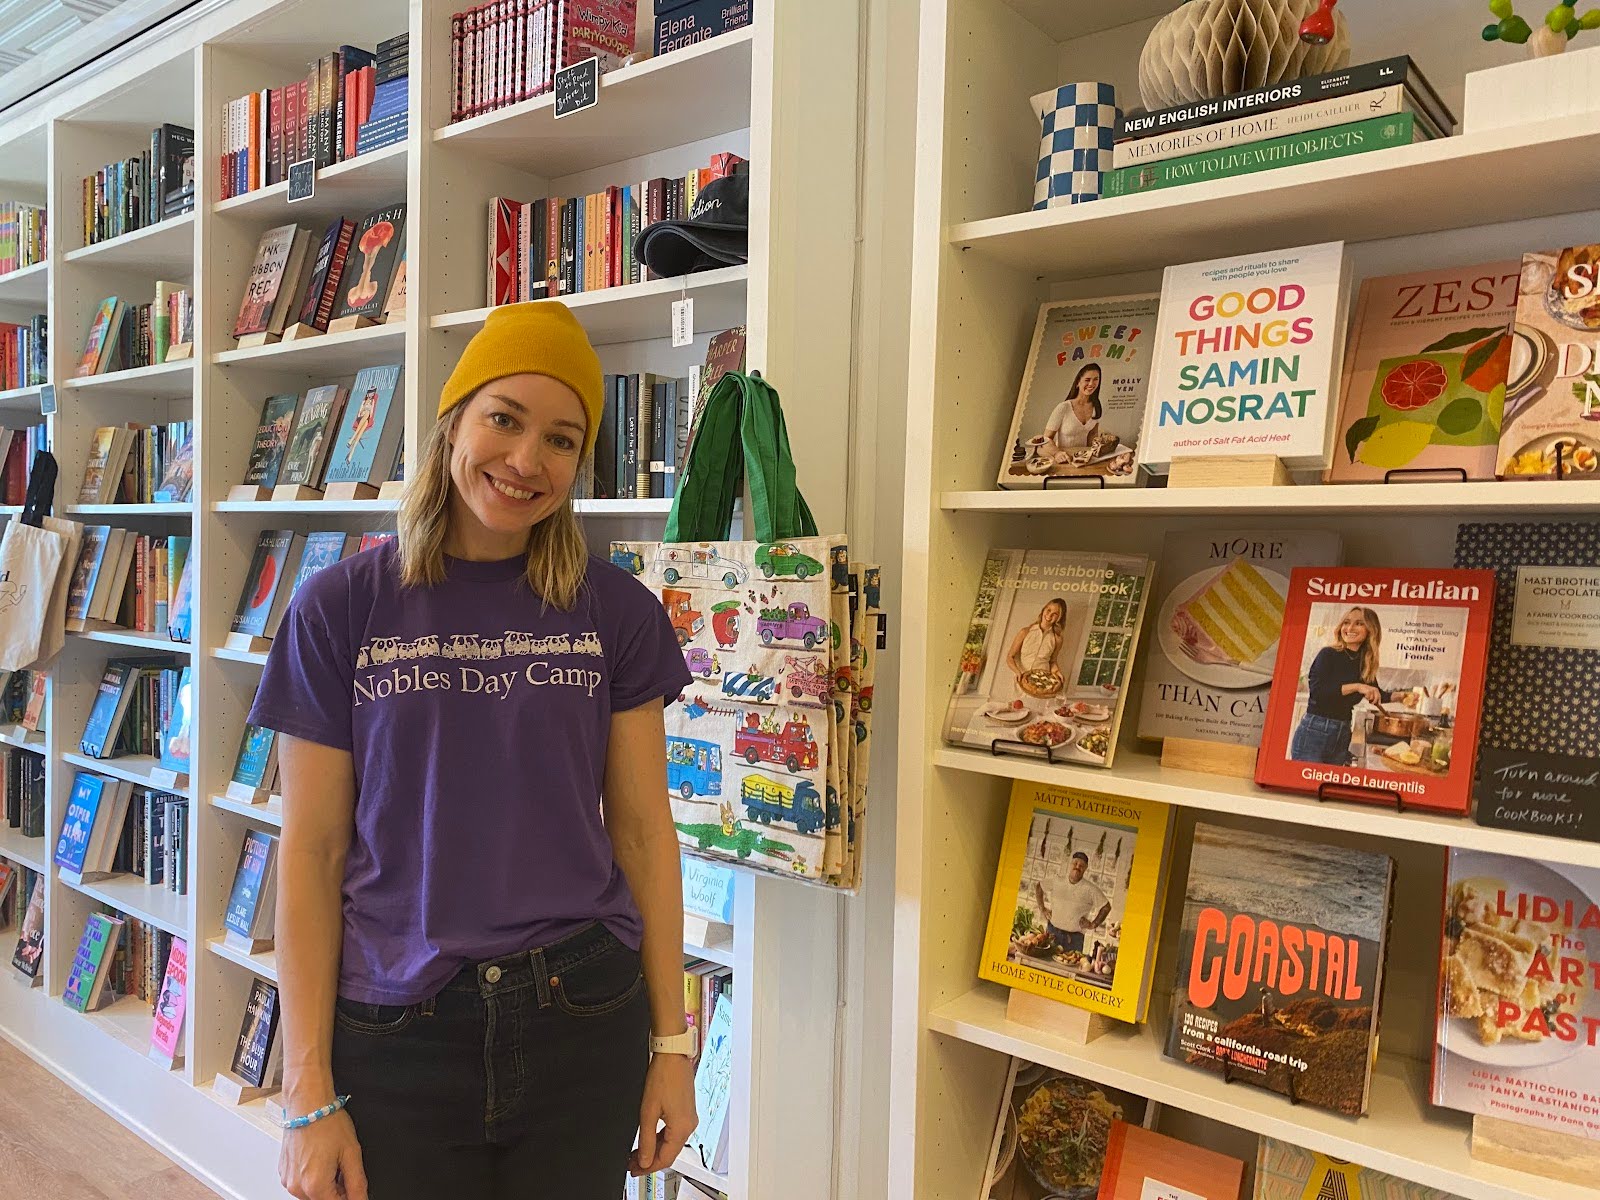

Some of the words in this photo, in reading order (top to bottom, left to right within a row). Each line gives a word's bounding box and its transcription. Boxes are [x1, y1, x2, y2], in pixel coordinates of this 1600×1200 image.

[577, 4, 611, 32] Wimpy
[611, 16, 629, 38] Kid
[721, 1, 749, 19] Brilliant
[724, 10, 748, 29] Friend
[660, 15, 695, 39] Elena
[659, 26, 713, 56] Ferrante
[556, 69, 575, 90] Stuff
[565, 81, 572, 90] to
[572, 68, 589, 87] Read
[1320, 75, 1350, 85] ELIZABETH
[557, 88, 580, 111] Before
[1124, 117, 1156, 133] NEW
[1158, 102, 1219, 126] ENGLISH
[1222, 85, 1302, 113] INTERIORS
[1287, 112, 1312, 125] HEIDI
[1314, 102, 1361, 119] CAILLIER
[1127, 132, 1203, 160] MEMORIES
[1205, 129, 1228, 144] OF
[1230, 117, 1279, 139] HOME
[1165, 163, 1199, 180] HOW
[1200, 158, 1219, 175] TO
[1219, 151, 1252, 170] LIVE
[1254, 142, 1295, 164] WITH
[1295, 131, 1364, 156] OBJECTS
[362, 208, 403, 230] FLESH
[263, 243, 281, 257] INK
[334, 253, 345, 266] IS
[251, 259, 284, 277] RIBBON
[327, 267, 341, 287] SHE
[1202, 267, 1228, 277] recipes
[1230, 264, 1244, 273] and
[1245, 260, 1268, 272] rituals
[1268, 259, 1277, 267] to
[1278, 257, 1300, 267] share
[1211, 273, 1227, 282] with
[1228, 271, 1254, 281] people
[1255, 269, 1269, 278] you
[1270, 265, 1288, 274] love
[249, 280, 272, 296] RED
[1392, 273, 1521, 320] ZEST
[316, 288, 335, 325] HIDING
[1189, 284, 1306, 322] GOOD
[1062, 324, 1142, 346] SWEET
[1175, 317, 1314, 356] THINGS
[708, 338, 738, 361] HARPER
[1056, 344, 1137, 366] FARM!
[709, 363, 724, 380] LEE
[1112, 377, 1142, 385] MOLLY
[1178, 355, 1300, 391] SAMIN
[1158, 389, 1316, 427] NOSRAT
[256, 440, 279, 449] THEORY
[1173, 438, 1200, 448] author
[1202, 437, 1213, 446] of
[1212, 436, 1230, 446] Salt
[1231, 436, 1245, 445] Fat
[1246, 434, 1267, 443] Acid
[1269, 433, 1291, 442] Heat
[1209, 537, 1282, 560] MORE
[1015, 563, 1039, 575] the
[1043, 564, 1115, 579] wishbone
[1524, 577, 1554, 585] MAST
[1555, 577, 1600, 587] BROTHE
[996, 577, 1048, 591] kitchen
[1052, 581, 1128, 596] cookbook
[1306, 577, 1387, 601] Super
[1391, 579, 1480, 601] Italian
[1532, 587, 1600, 597] CHOCOLATE
[233, 614, 251, 624] SUSAN
[1396, 643, 1446, 653] Healthiest
[1405, 652, 1434, 661] Foods
[353, 665, 450, 707] Nobles
[459, 666, 518, 700] Day
[525, 661, 601, 697] Camp
[1158, 683, 1221, 713] THAN
[1230, 694, 1265, 718] CA
[1165, 713, 1183, 722] Baking
[1184, 715, 1205, 724] Recipes
[1301, 768, 1340, 784] Giada
[1342, 773, 1361, 786] De
[1362, 775, 1426, 795] Laurentiis
[1494, 762, 1539, 783] Turn
[1544, 771, 1599, 787] around
[78, 786, 92, 801] MY
[1496, 783, 1523, 800] for
[1531, 791, 1569, 803] more
[68, 803, 91, 823] OTHER
[1033, 791, 1075, 807] MATTY
[1075, 800, 1143, 820] MATHESON
[62, 823, 86, 844] HEART
[689, 866, 724, 888] Virginia
[692, 886, 717, 908] Woolf
[1496, 889, 1600, 931] LIDIA
[1550, 933, 1586, 952] The
[1188, 907, 1363, 1009] COASTAL
[1525, 956, 1600, 991] ART
[991, 961, 1026, 981] HOME
[1028, 972, 1064, 992] STYLE
[1066, 983, 1124, 1009] COOKERY
[254, 990, 270, 1007] PAULA
[1555, 991, 1577, 1007] of
[247, 1002, 271, 1025] HAWKINS
[1194, 1015, 1219, 1034] RECIPES
[1495, 1000, 1600, 1047] PAST
[239, 1034, 251, 1050] THE
[251, 1042, 265, 1059] BLUE
[1180, 1039, 1196, 1049] Scott
[1182, 1025, 1205, 1042] from
[1207, 1033, 1213, 1042] a
[1214, 1036, 1262, 1057] california
[1263, 1051, 1288, 1065] road
[1288, 1055, 1308, 1072] trip
[240, 1054, 258, 1072] HOUR
[1231, 1050, 1268, 1071] LUNCHEONETTE
[1472, 1069, 1500, 1081] LIDIA
[1505, 1076, 1578, 1099] MATTICCHIO
[1468, 1081, 1486, 1091] and
[1490, 1085, 1525, 1099] TANYA
[1530, 1094, 1599, 1116] BASTIANICH
[1490, 1100, 1545, 1118] Photographs
[1547, 1112, 1558, 1121] by
[1560, 1116, 1584, 1126] Dana
